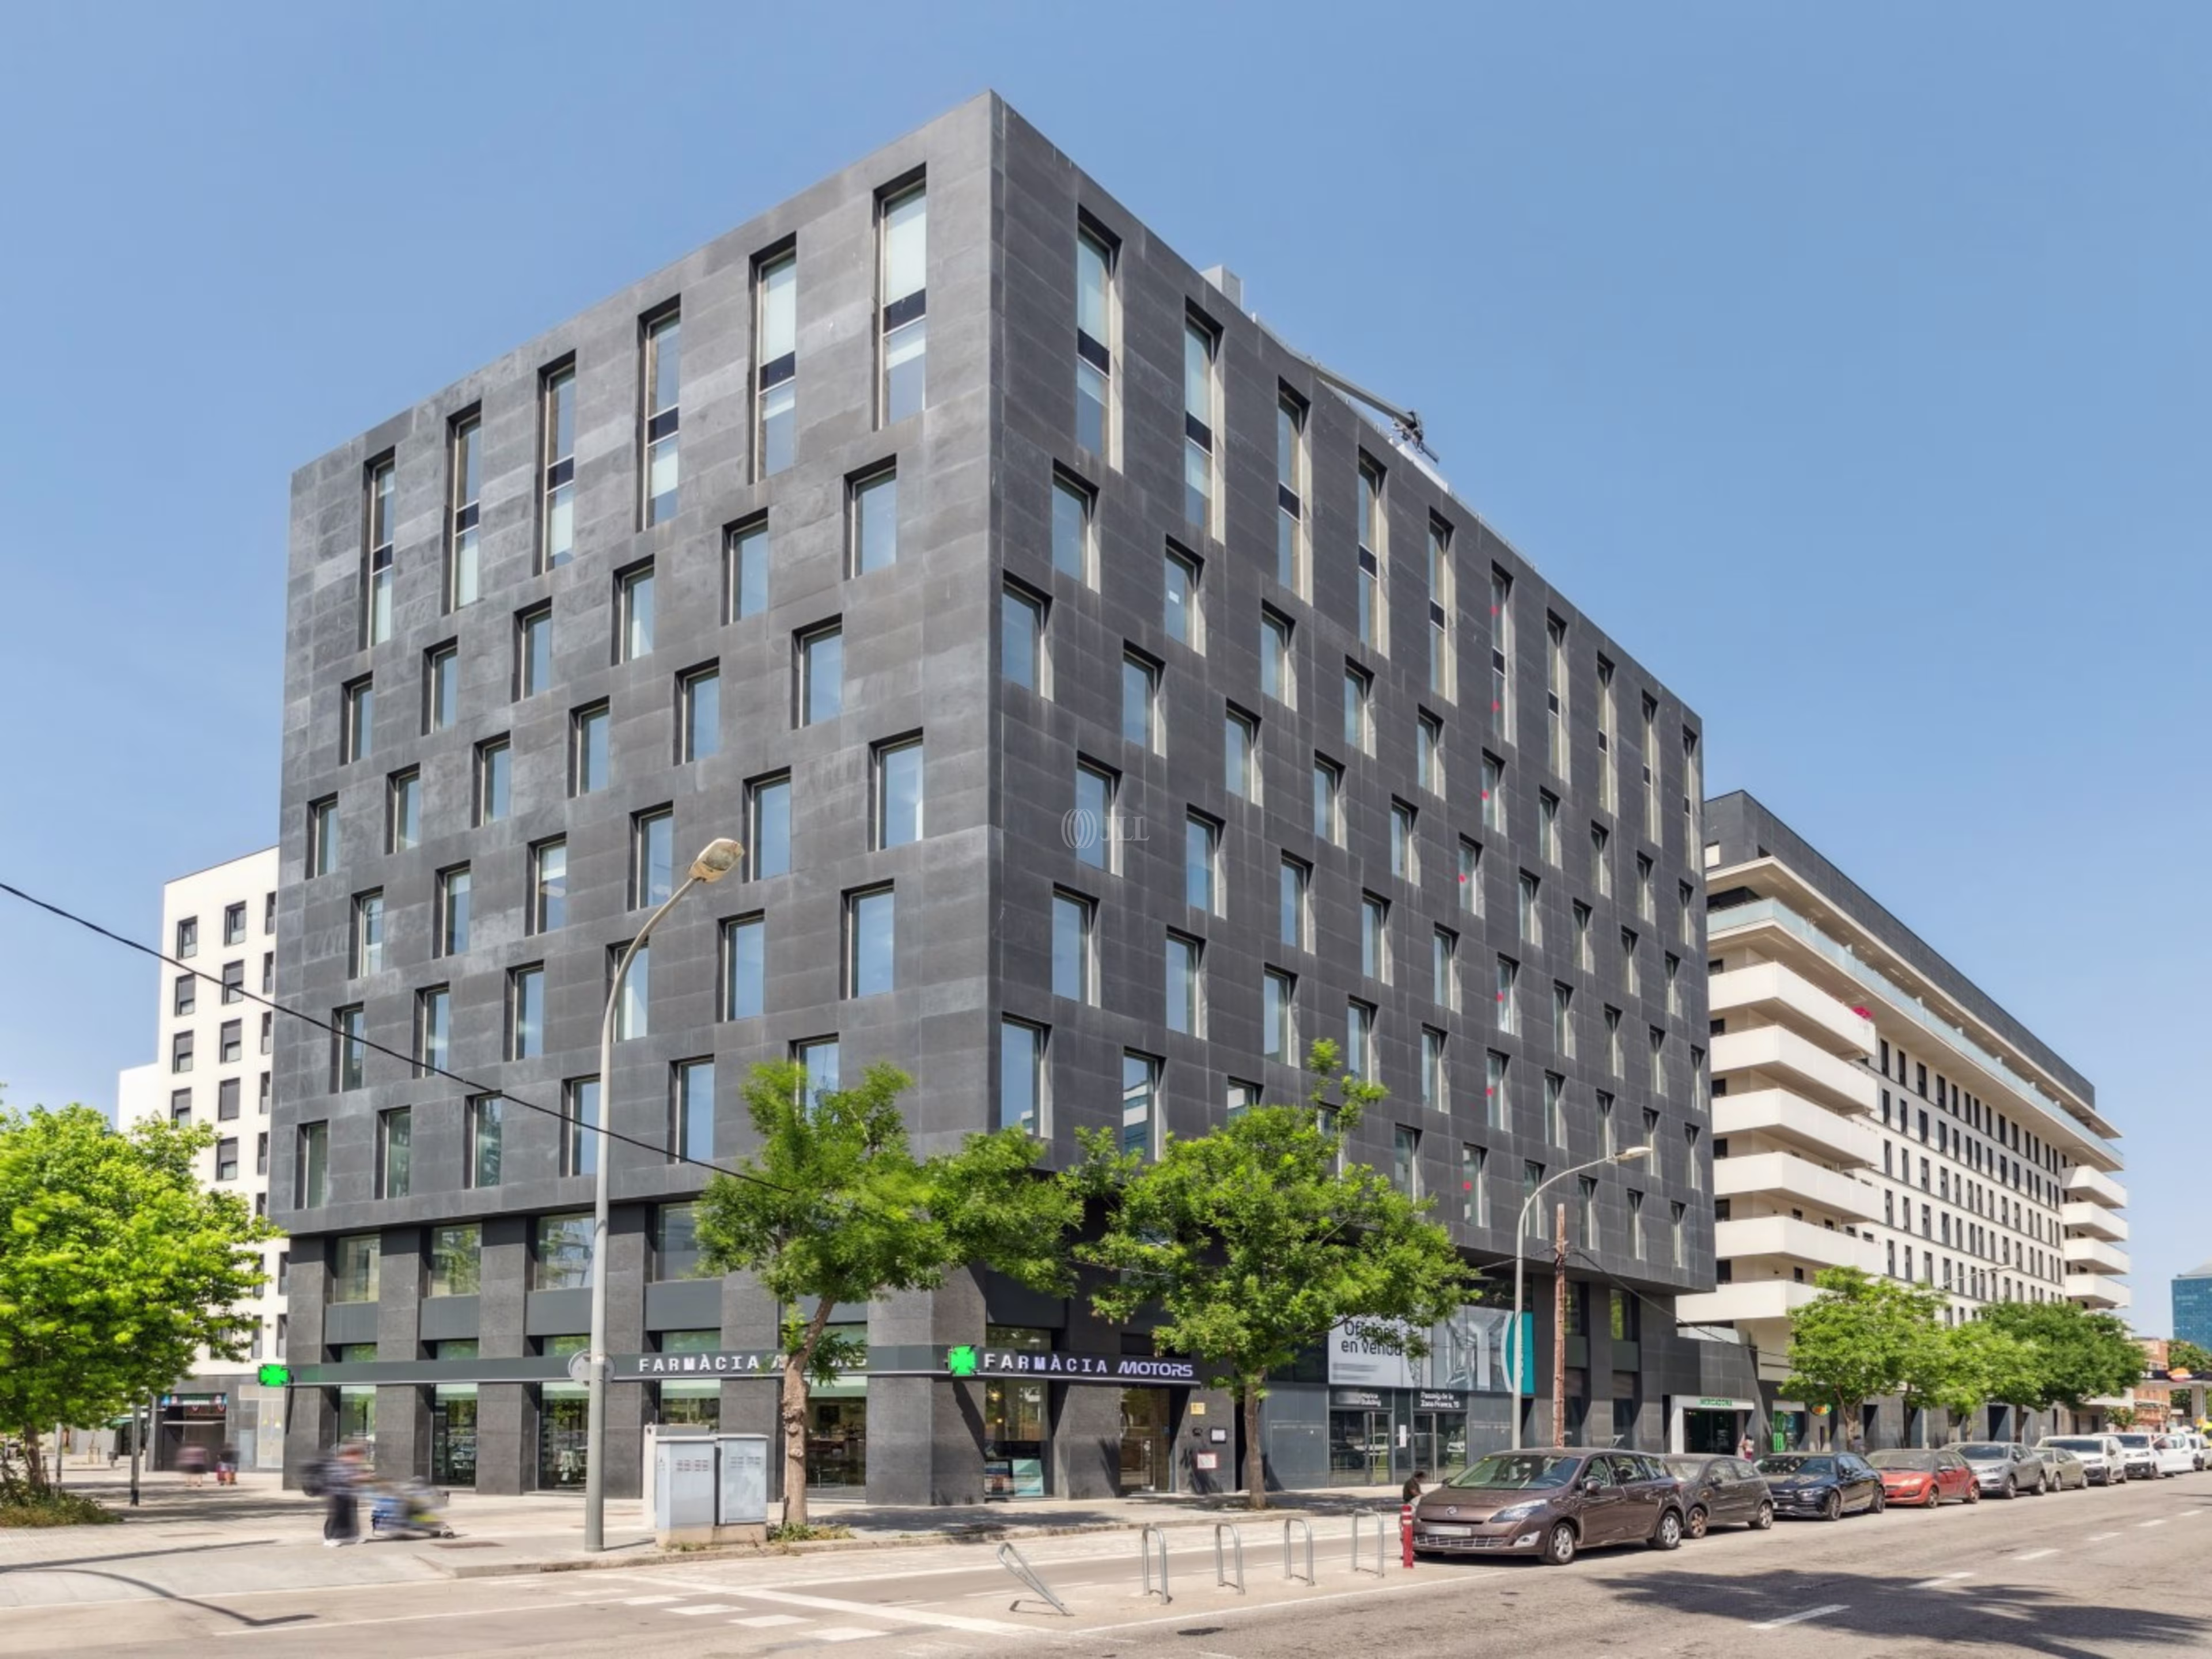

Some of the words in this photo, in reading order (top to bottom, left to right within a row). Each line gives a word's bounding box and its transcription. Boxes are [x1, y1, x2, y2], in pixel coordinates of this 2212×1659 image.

[1341, 1340, 1358, 1353] en
[639, 1354, 759, 1372] FARMÀCIA
[984, 1354, 1108, 1373] FARMÀCIA
[1118, 1361, 1194, 1377] MOTORS
